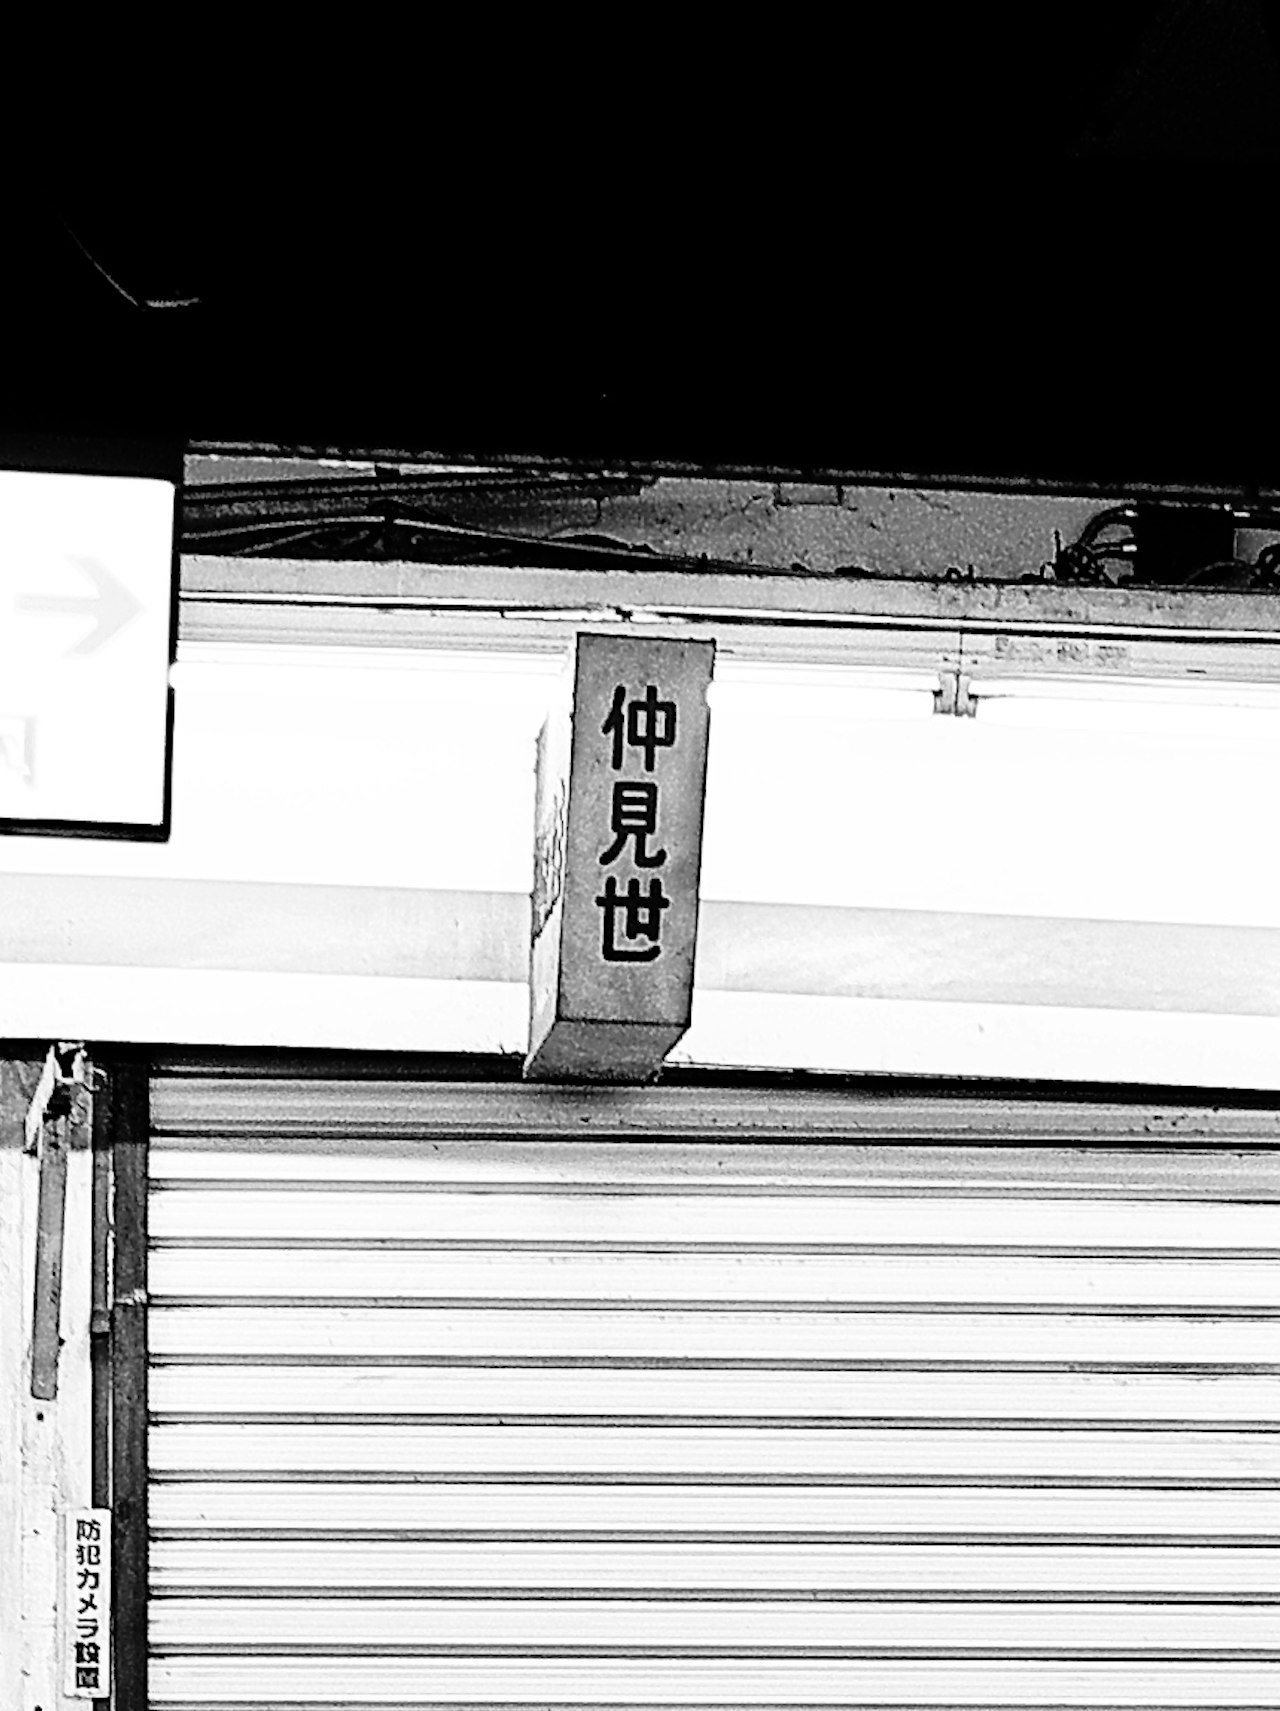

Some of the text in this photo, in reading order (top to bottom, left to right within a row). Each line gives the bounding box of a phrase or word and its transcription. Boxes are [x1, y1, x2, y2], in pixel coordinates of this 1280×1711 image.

[595, 685, 679, 963] 仲見世
[74, 1518, 102, 1689] 防犯カメラ設置
